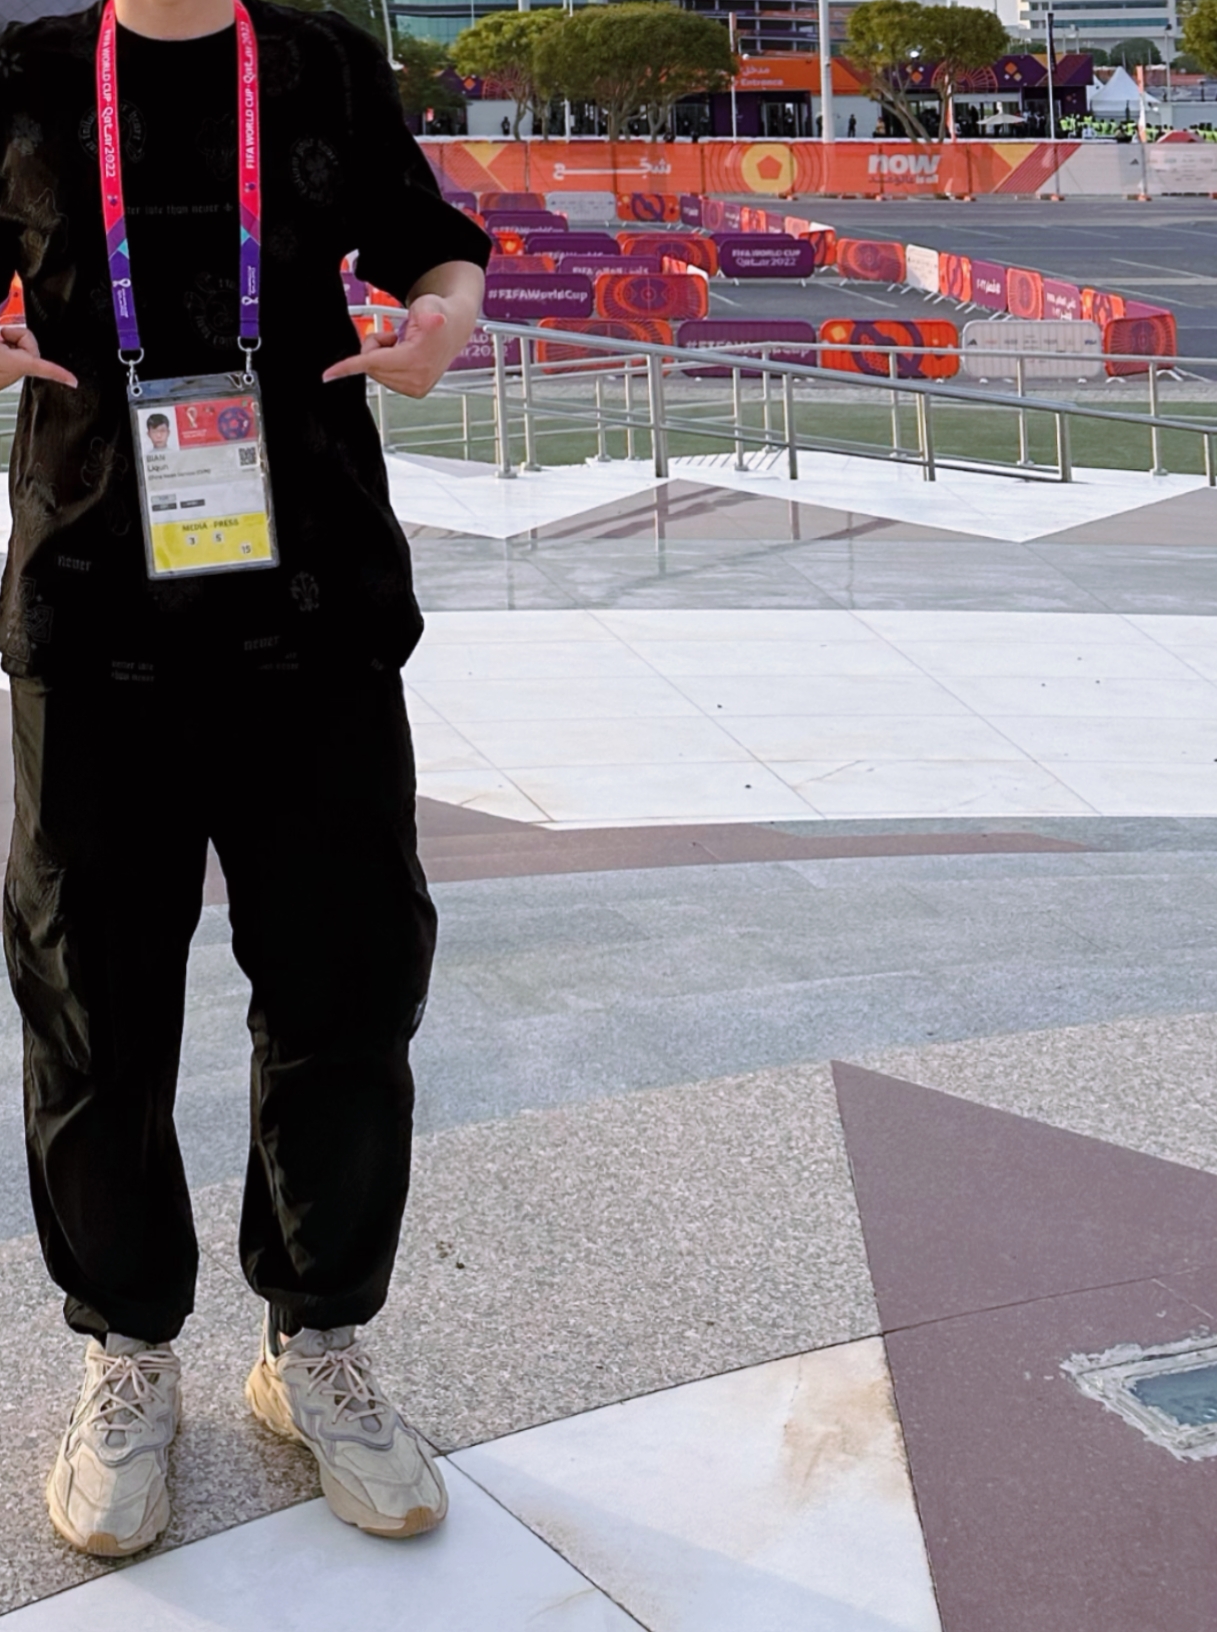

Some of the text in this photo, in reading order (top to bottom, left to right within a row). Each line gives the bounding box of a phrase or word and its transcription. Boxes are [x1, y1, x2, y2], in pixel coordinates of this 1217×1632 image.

[102, 48, 113, 81] WORLD
[103, 82, 113, 102] CUP
[245, 89, 255, 108] CUP
[245, 110, 255, 148] WORLD
[101, 106, 116, 178] Qatar2022
[246, 150, 255, 169] FIFA
[868, 154, 942, 175] now
[487, 289, 588, 302] #FIFAWorldCup
[182, 519, 239, 532] MEDIA PRESS
[241, 545, 251, 555] 15
